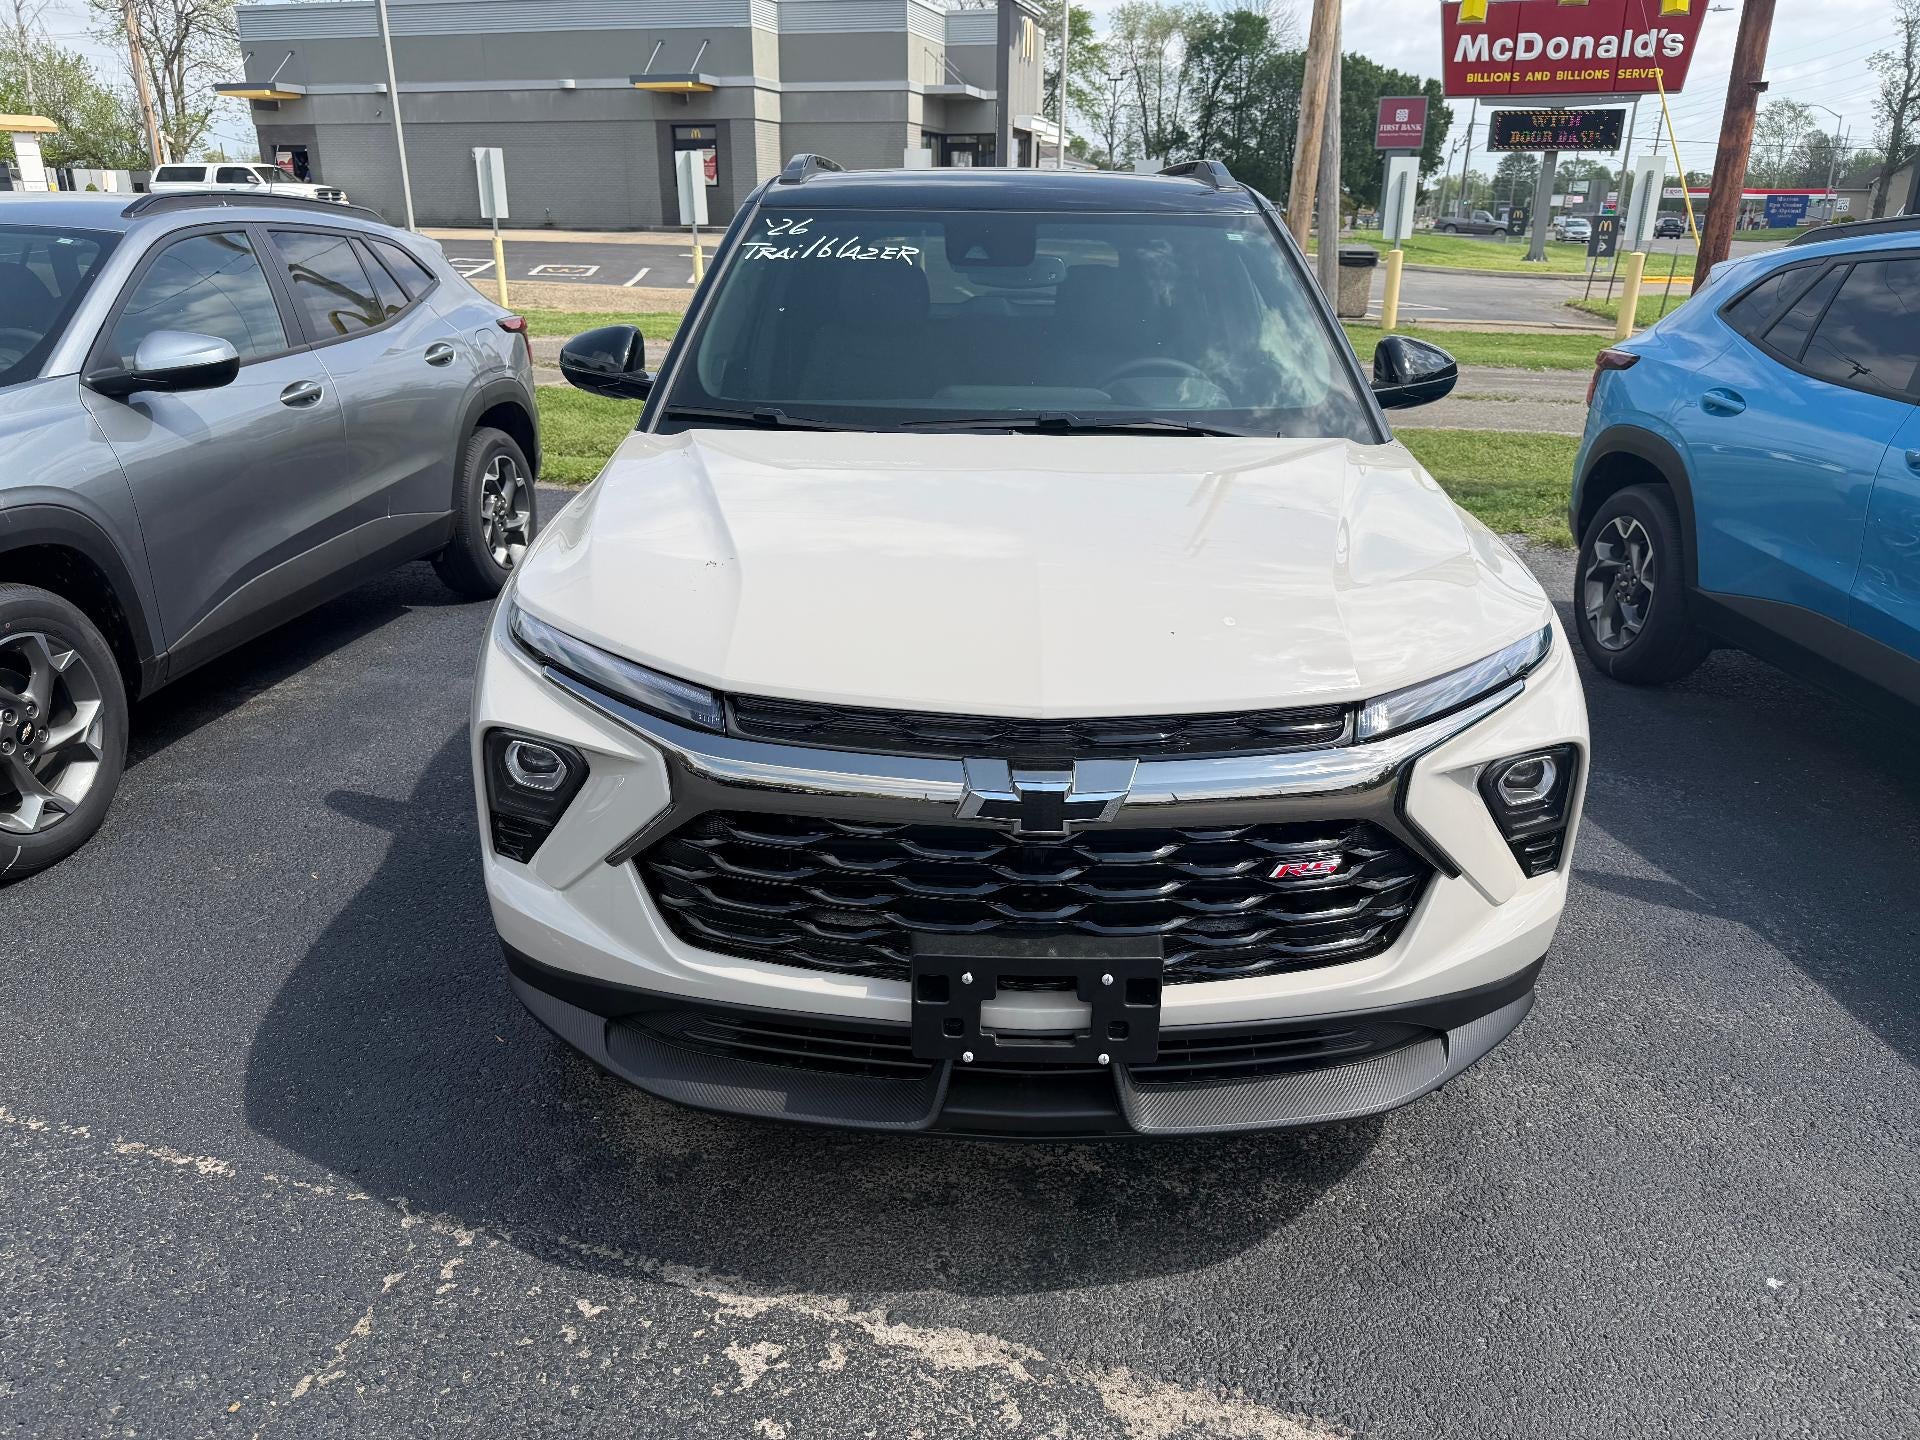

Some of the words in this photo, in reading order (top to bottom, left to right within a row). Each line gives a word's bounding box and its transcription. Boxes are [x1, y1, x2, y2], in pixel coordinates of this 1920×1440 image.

[1453, 28, 1685, 63] McDonald's
[1466, 71, 1521, 83] BILLIONS
[1525, 71, 1551, 82] AND
[1556, 69, 1610, 81] BILLIONS
[1617, 68, 1664, 79] SERVED
[1379, 123, 1400, 131] FIRST
[1401, 123, 1422, 131] BANK
[1531, 115, 1582, 128] WITH
[1268, 859, 1341, 878] RS
